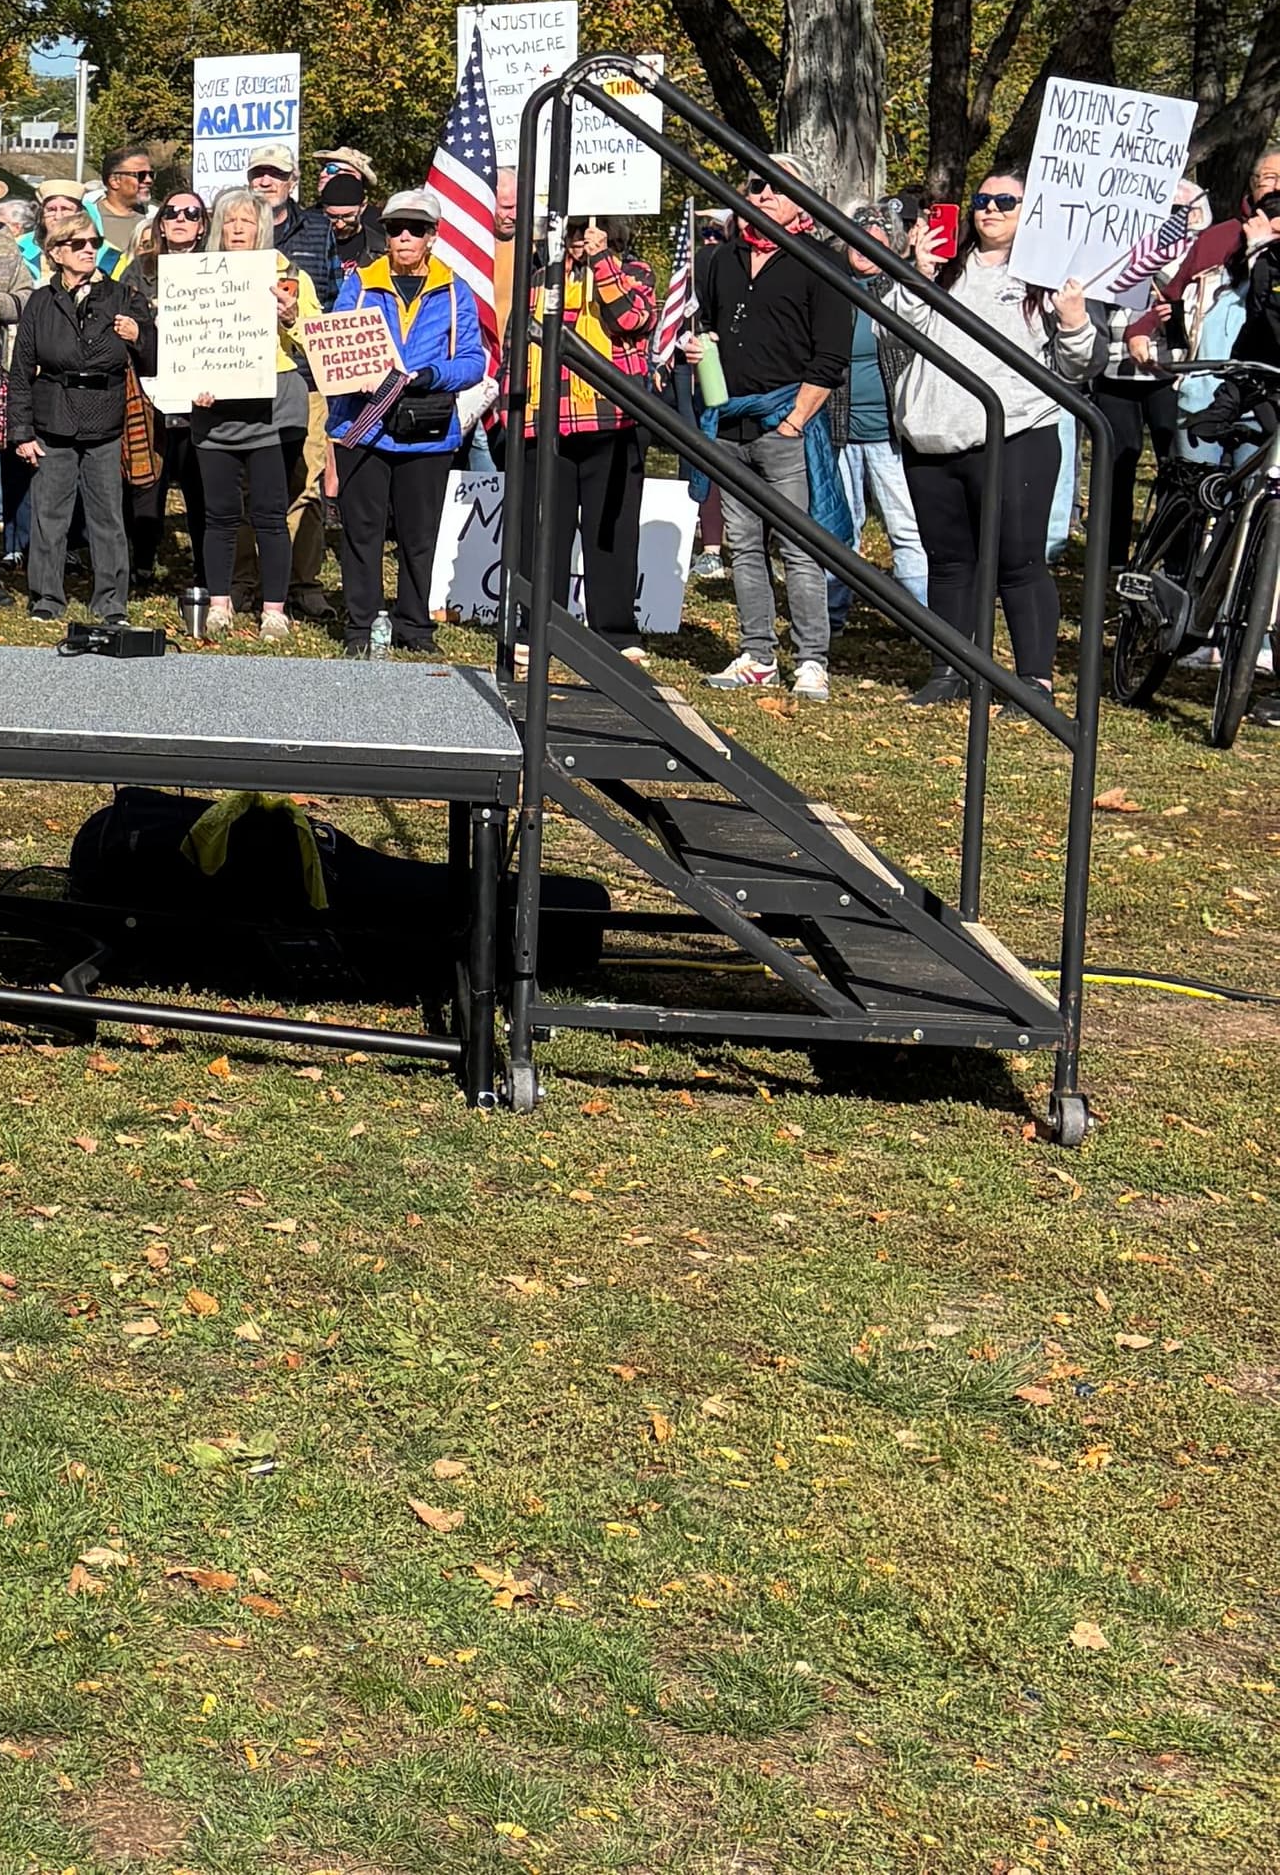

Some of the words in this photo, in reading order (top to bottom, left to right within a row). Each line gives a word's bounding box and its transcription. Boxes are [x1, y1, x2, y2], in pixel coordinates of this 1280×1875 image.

[485, 12, 565, 31] NJUSTICE
[507, 62, 518, 74] IS
[524, 60, 534, 72] A
[195, 78, 229, 98] WE
[236, 74, 297, 96] FOUGHT
[197, 99, 297, 135] AGAINST
[1049, 85, 1135, 126] NOTHING
[1137, 102, 1159, 135] IS
[575, 138, 645, 155] ALTHCARE
[1054, 124, 1100, 156] MORE
[1110, 132, 1185, 169] AMERICAN
[197, 152, 208, 172] A
[215, 148, 249, 172] KIN
[1040, 155, 1084, 189] THAN
[1098, 167, 1168, 204] OPPOSING
[1025, 193, 1043, 229] A
[1060, 201, 1166, 247] TYRANT
[304, 314, 382, 335] AMERICAN
[309, 328, 386, 352] PATRIOTS
[323, 344, 388, 366] AGAINST
[326, 358, 395, 382] FASCISM
[455, 476, 499, 502] Bring
